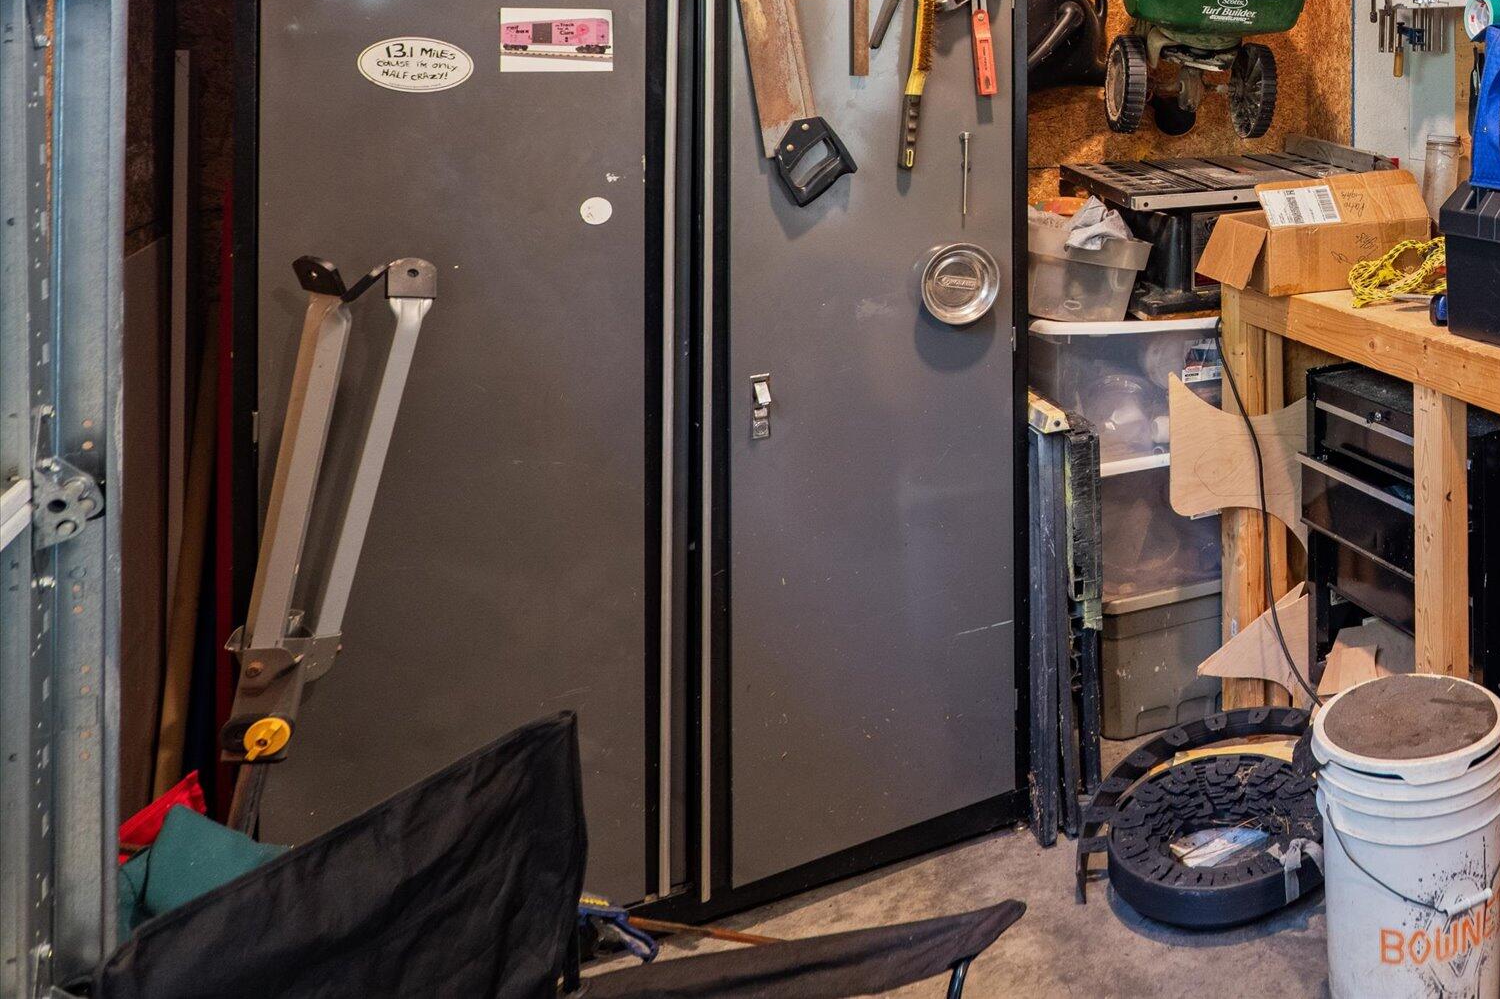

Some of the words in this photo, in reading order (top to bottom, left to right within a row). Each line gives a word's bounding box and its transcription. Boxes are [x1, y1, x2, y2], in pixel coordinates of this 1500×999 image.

[1201, 5, 1222, 16] Turf
[1221, 8, 1257, 18] Builder
[385, 43, 413, 58] 13.1
